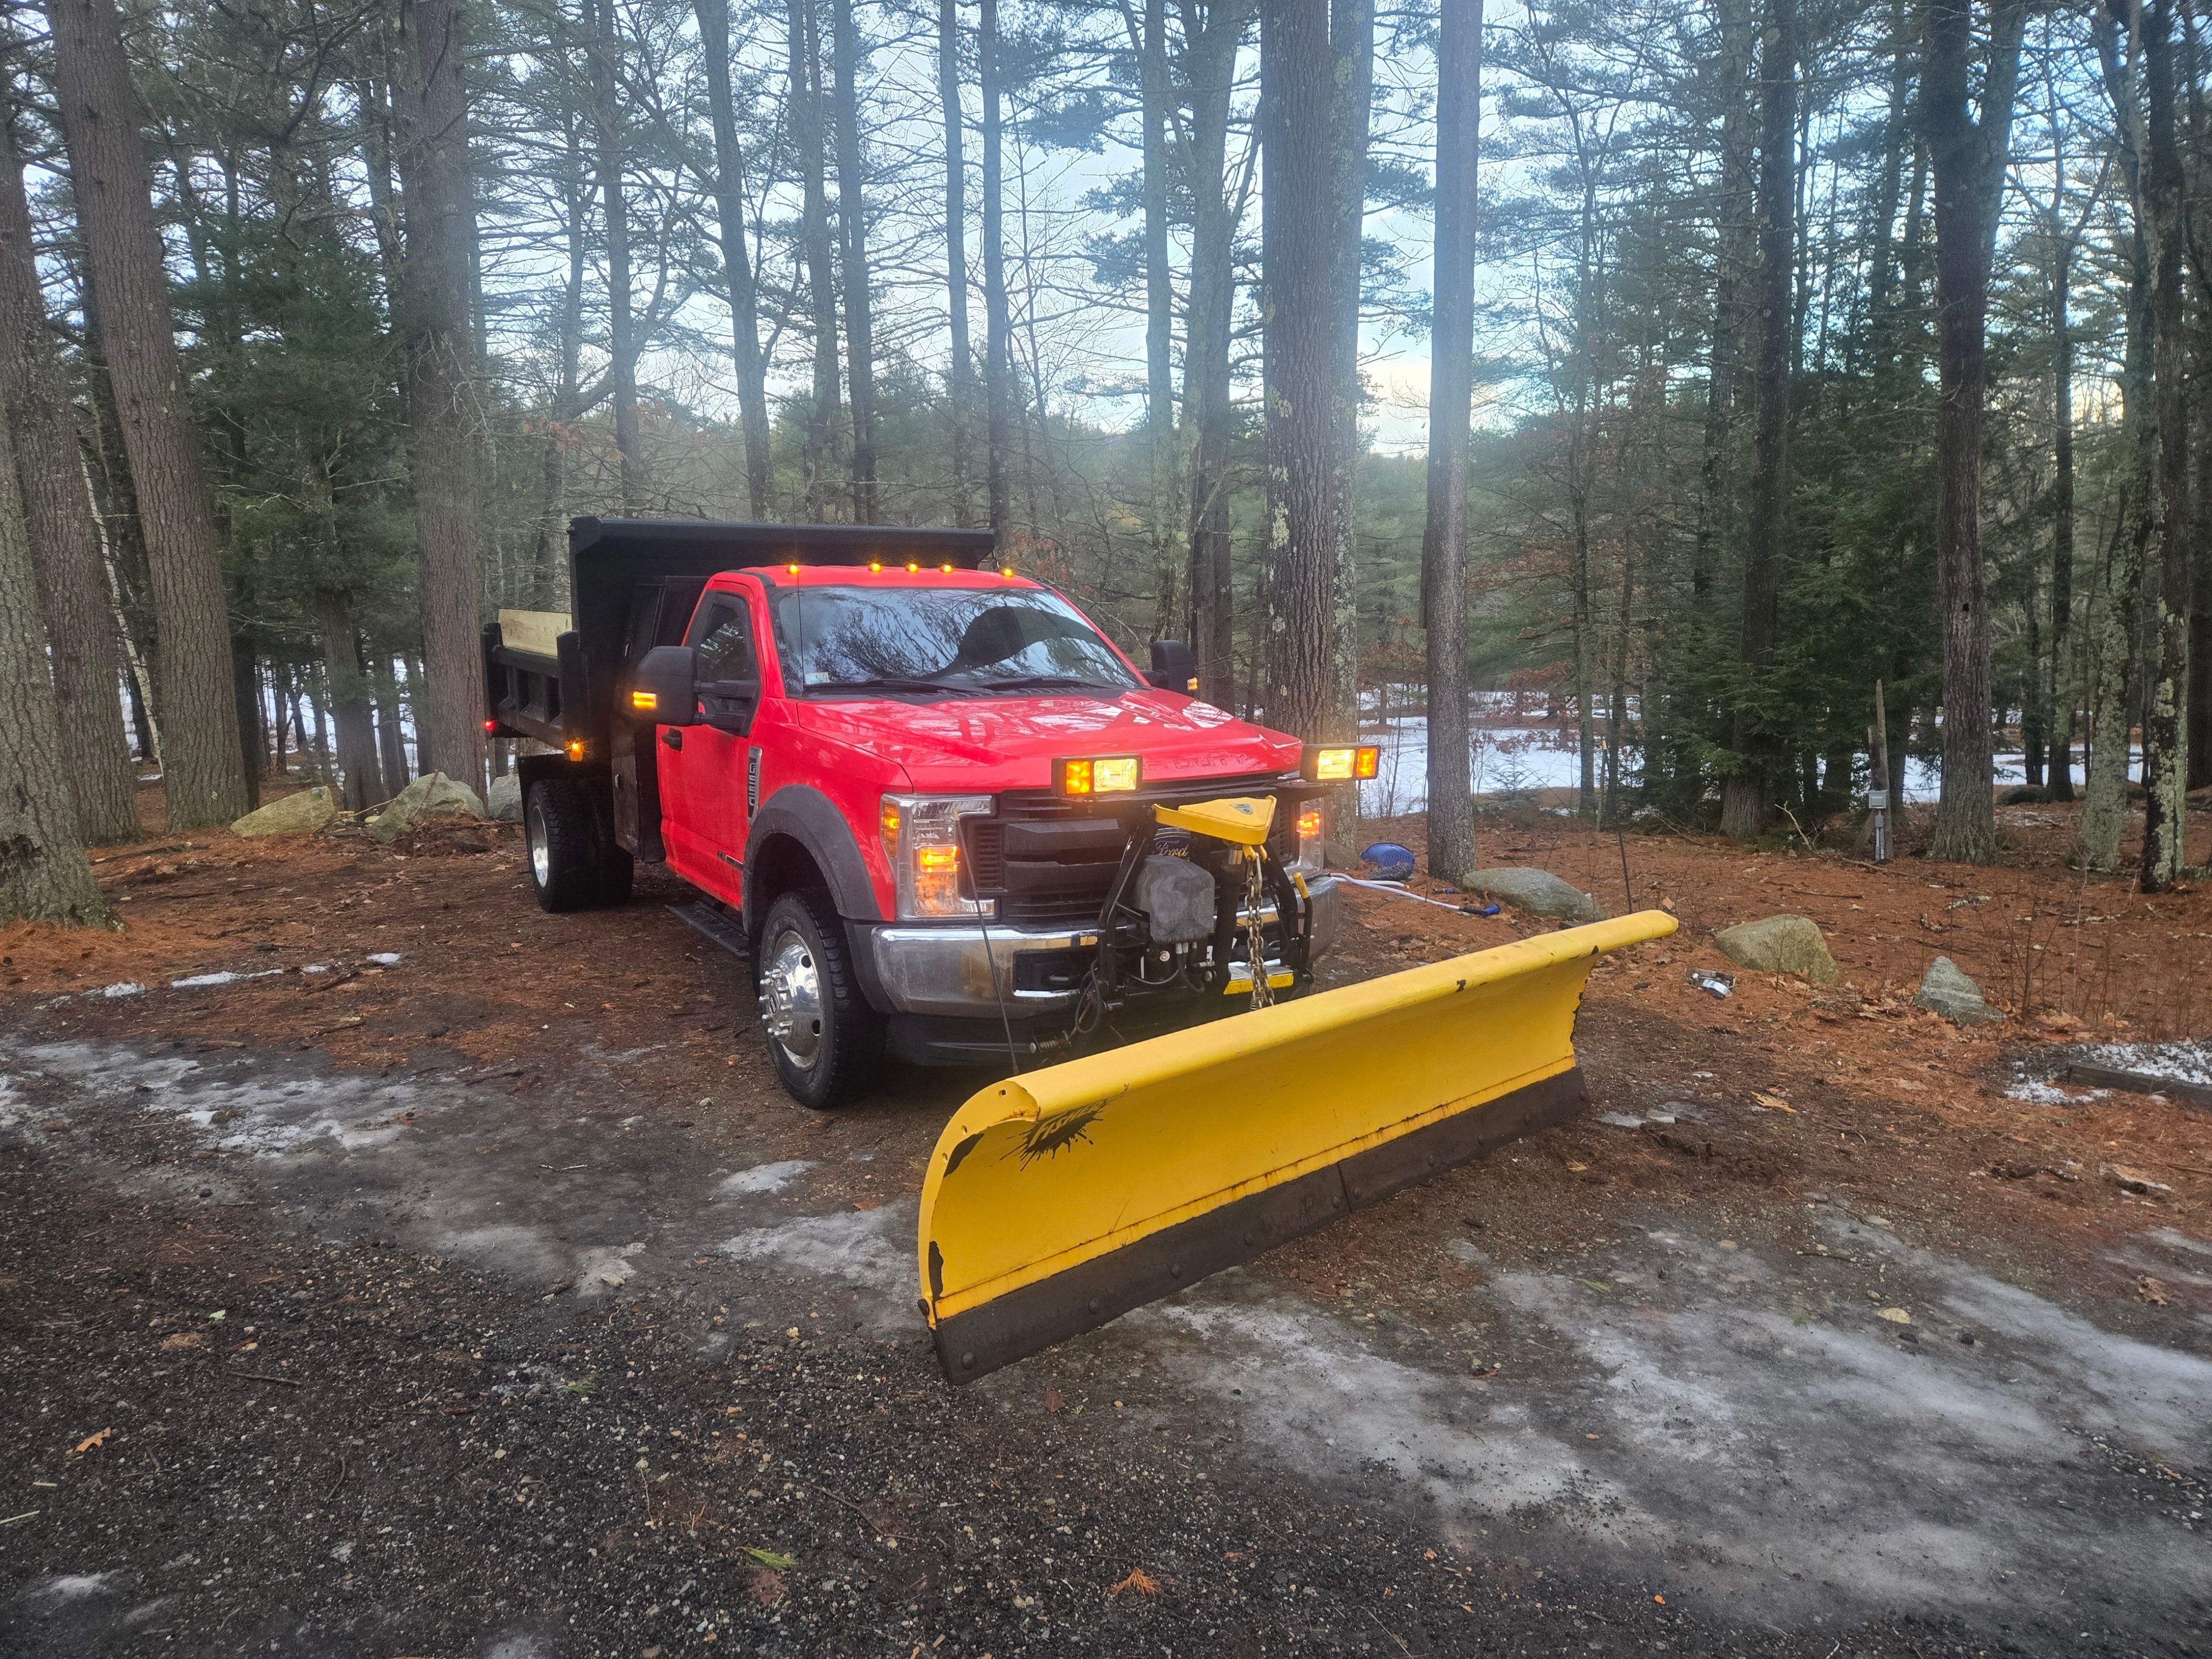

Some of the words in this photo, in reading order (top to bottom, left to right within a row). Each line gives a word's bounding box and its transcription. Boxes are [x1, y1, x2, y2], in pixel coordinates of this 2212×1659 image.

[1173, 753, 1246, 769] DUTY
[1155, 839, 1190, 857] Ford
[1029, 1100, 1106, 1147] FISHER
